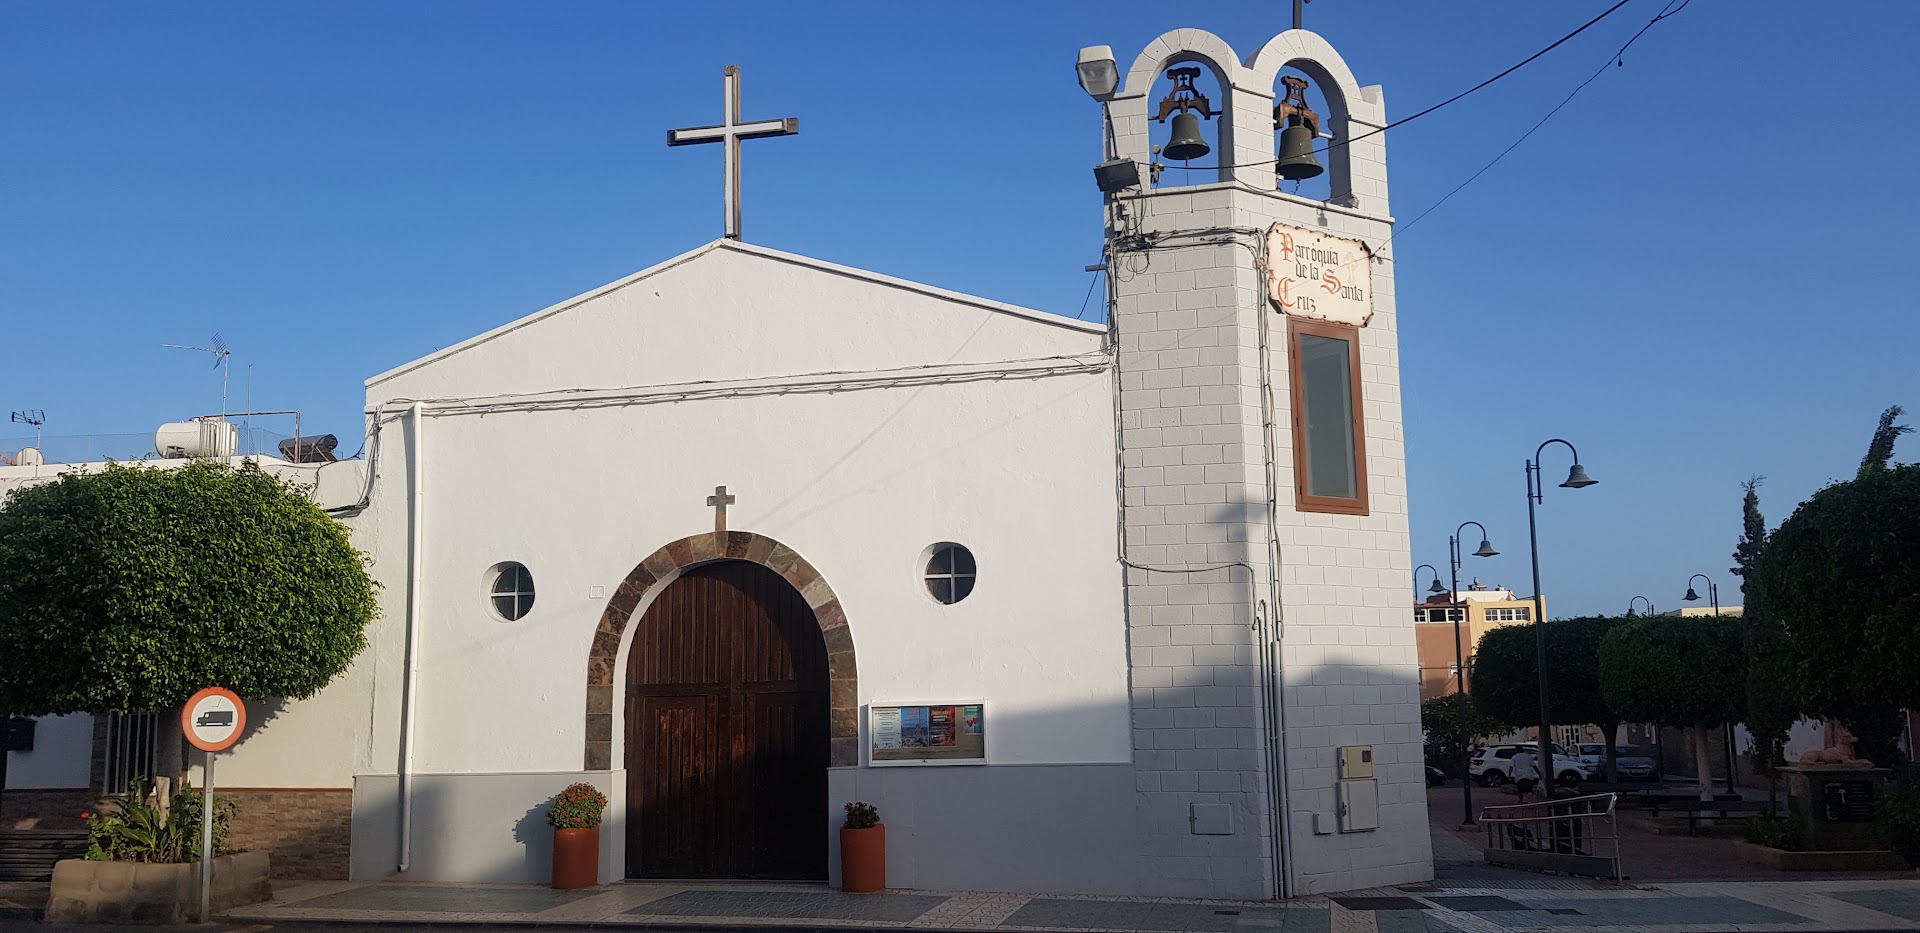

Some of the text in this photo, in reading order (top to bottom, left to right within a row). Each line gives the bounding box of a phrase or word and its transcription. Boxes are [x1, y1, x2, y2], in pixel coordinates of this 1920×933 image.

[1277, 277, 1316, 312] Cruz
[1295, 258, 1363, 301] de la Santa
